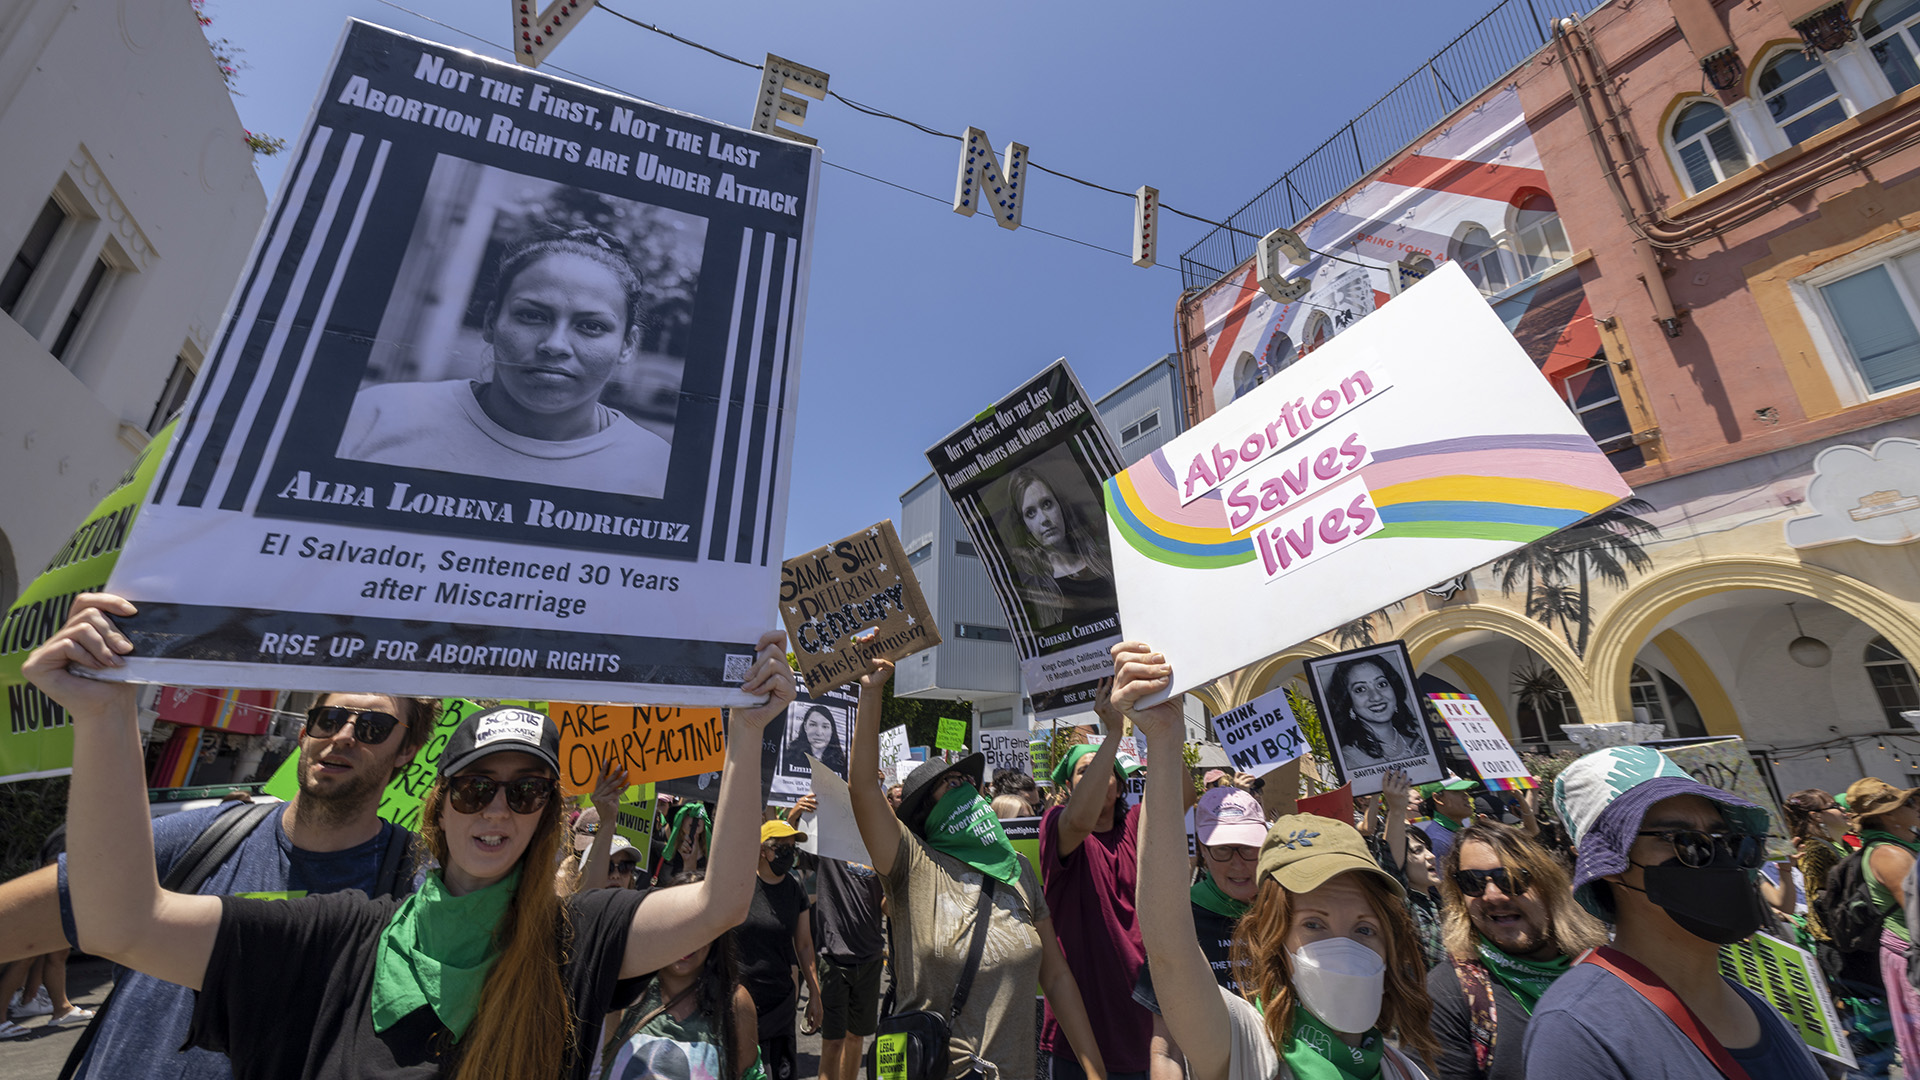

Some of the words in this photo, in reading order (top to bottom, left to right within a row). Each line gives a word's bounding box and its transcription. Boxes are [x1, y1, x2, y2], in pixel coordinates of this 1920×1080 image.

[415, 53, 476, 94] NOT
[480, 75, 522, 108] THE
[528, 83, 604, 131] FIRST,
[609, 107, 660, 143] NOT
[665, 125, 702, 156] THE
[707, 133, 760, 169] LAST
[338, 75, 481, 138] ABORTION
[485, 113, 582, 164] RIGHTS
[586, 148, 630, 176] ARE
[635, 153, 711, 195] UNDER
[714, 174, 799, 217] ATTACK
[1357, 232, 1395, 248] BRING
[944, 444, 964, 462] NOT
[960, 434, 975, 452] THE
[971, 421, 1000, 447] FIRST,
[994, 410, 1014, 431] NOT
[1013, 402, 1031, 420] THE
[1026, 386, 1053, 410] LAST
[1184, 370, 1374, 498] Abortion
[943, 459, 981, 491] ABORTION
[975, 444, 1008, 471] RIGHTS
[1007, 437, 1023, 455] ARE
[1017, 420, 1051, 446] UNDER
[1045, 399, 1086, 430] ATTACK
[1227, 432, 1367, 530] Saves
[277, 470, 375, 510] ALBA
[387, 482, 514, 525] LORENA
[525, 498, 691, 544] RODRIGUEZ
[1256, 493, 1376, 577] lives
[259, 531, 289, 558] El
[297, 535, 427, 573] Salvador,
[438, 550, 569, 584] Sentenced
[578, 562, 610, 587] 30
[618, 566, 680, 593] Years
[780, 555, 836, 602] SAME
[835, 535, 884, 574] SHIT
[359, 575, 426, 601] after
[434, 580, 587, 618] Miscarriage
[1038, 631, 1072, 649] CHELSEA
[1072, 617, 1116, 639] CHEYENNE
[258, 631, 318, 658] RISE
[329, 635, 364, 660] UP
[373, 637, 418, 662] FOR
[426, 641, 539, 670] ABORTION
[546, 649, 621, 675] RIGHTS
[1041, 662, 1057, 672] Kings
[1054, 669, 1073, 680] Months
[1081, 661, 1102, 673] Murder
[1063, 694, 1077, 703] RISE
[1078, 691, 1086, 701] UP
[559, 705, 610, 740] ARE
[1216, 703, 1257, 731] THINK
[1227, 708, 1284, 745] OUTSIDE
[1461, 722, 1486, 734] THE
[569, 718, 723, 787] OVARY-ACTING
[1232, 744, 1262, 773] MY
[1464, 739, 1509, 752] SUPREME
[1353, 768, 1377, 779] SAVITA
[1482, 760, 1521, 774] COURT!
[948, 808, 985, 835] Overturn
[972, 819, 995, 837] HELL
[980, 831, 998, 846] NO!
[1757, 940, 1796, 1016] WITHOUT
[1781, 956, 1827, 1037] APOLOGY
[880, 1041, 895, 1053] LEGAL
